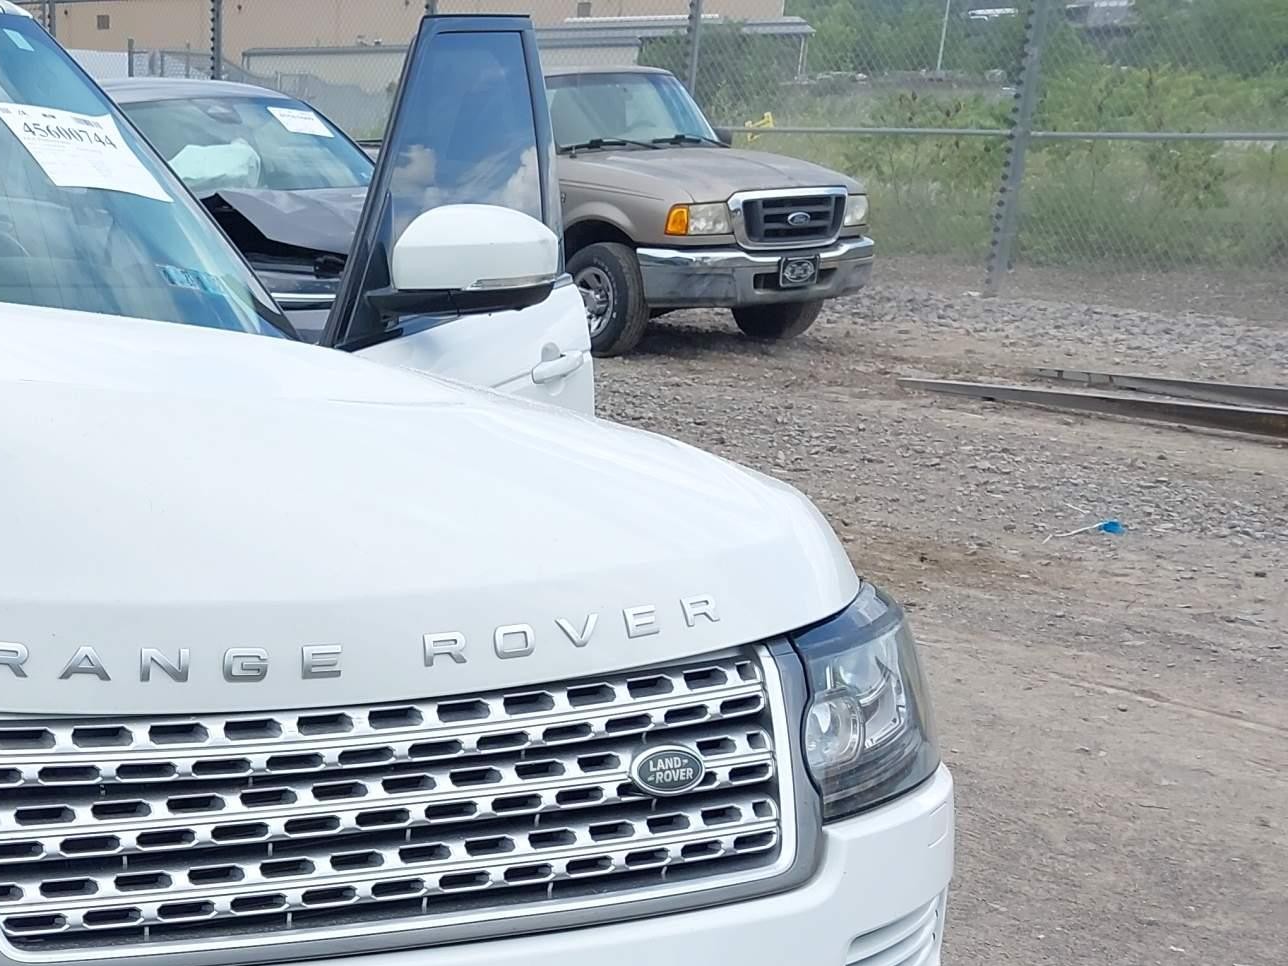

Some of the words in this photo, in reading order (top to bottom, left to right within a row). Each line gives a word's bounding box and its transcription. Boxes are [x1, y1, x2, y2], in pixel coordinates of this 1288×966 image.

[23, 121, 117, 149] 45600744
[422, 594, 720, 668] ROVER
[649, 757, 681, 772] LAND
[656, 767, 694, 783] ROVER
